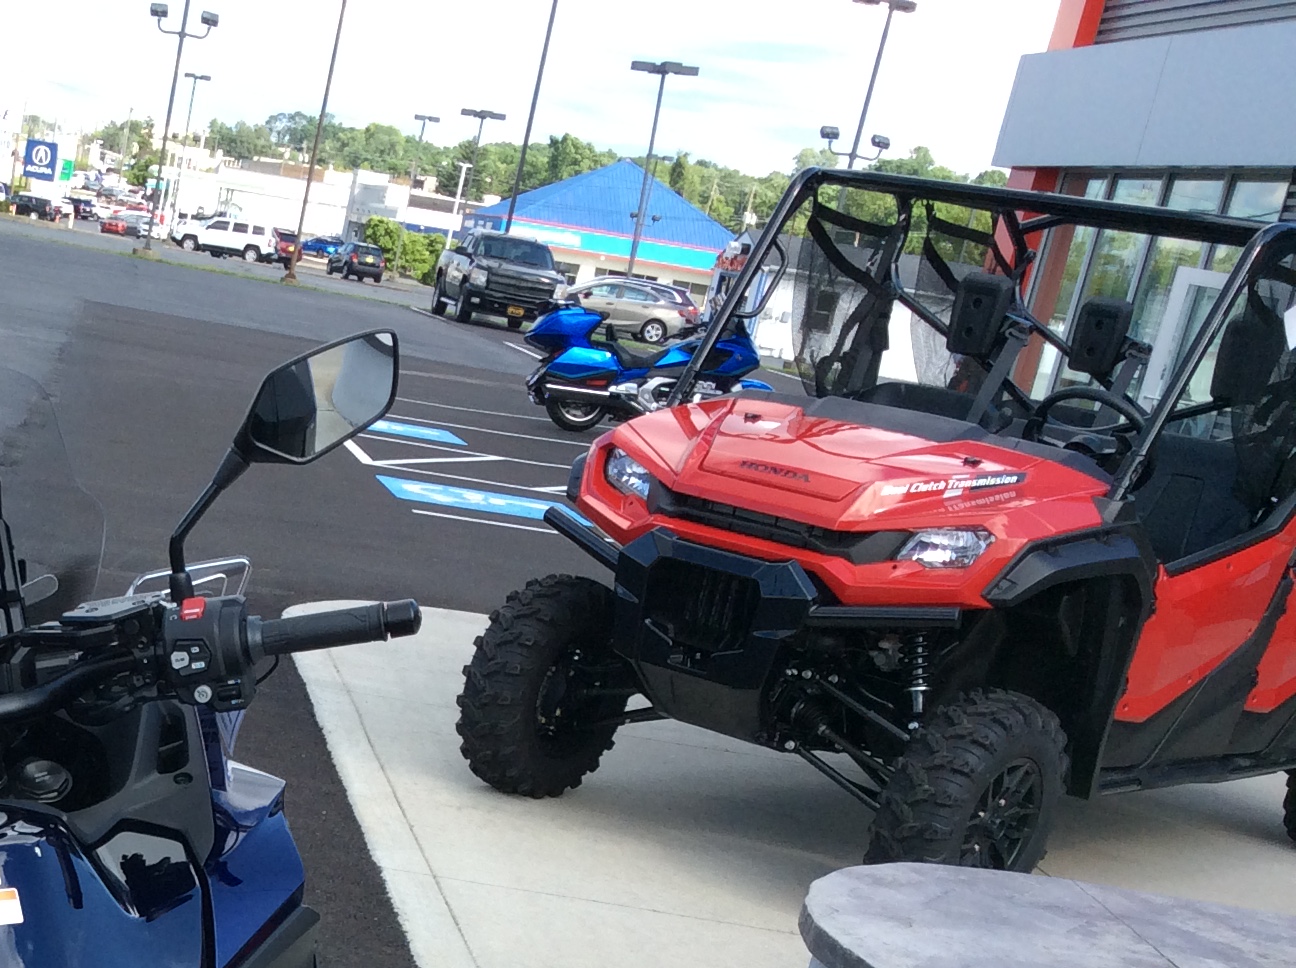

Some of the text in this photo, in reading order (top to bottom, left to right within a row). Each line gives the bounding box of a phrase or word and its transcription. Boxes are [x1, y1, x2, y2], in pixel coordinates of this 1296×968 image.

[25, 164, 53, 175] ACURA
[738, 459, 811, 483] HONDA
[910, 479, 946, 492] Clutch
[947, 474, 1018, 489] Transmission
